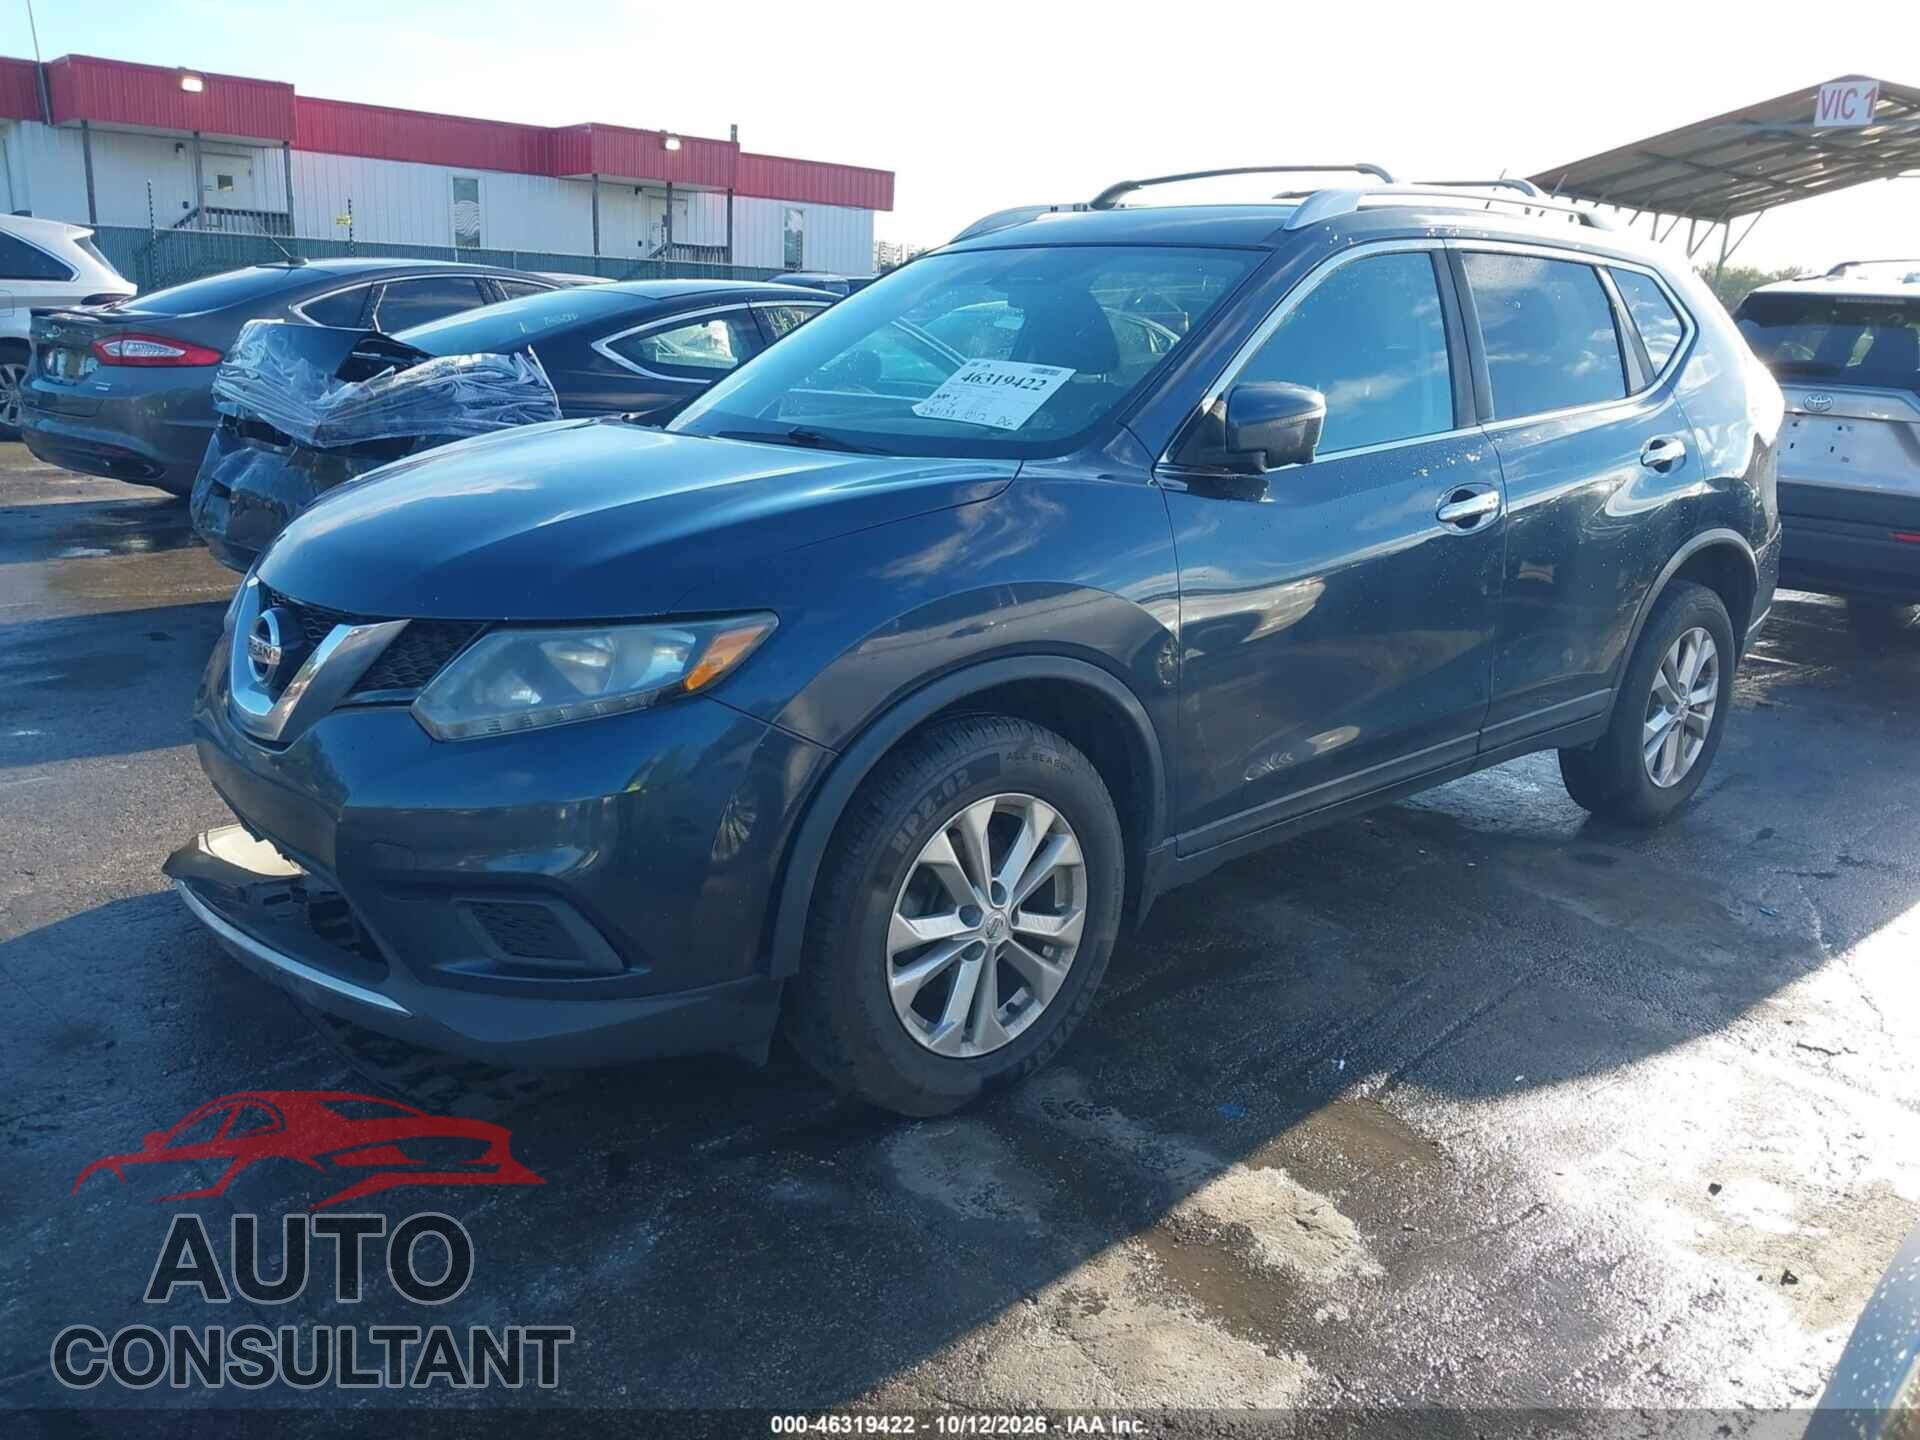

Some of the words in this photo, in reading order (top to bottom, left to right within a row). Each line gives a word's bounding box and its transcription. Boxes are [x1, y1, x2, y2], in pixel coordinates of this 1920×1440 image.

[1821, 87, 1858, 120] VIC
[1864, 87, 1877, 118] 1
[961, 372, 1047, 390] 46319422
